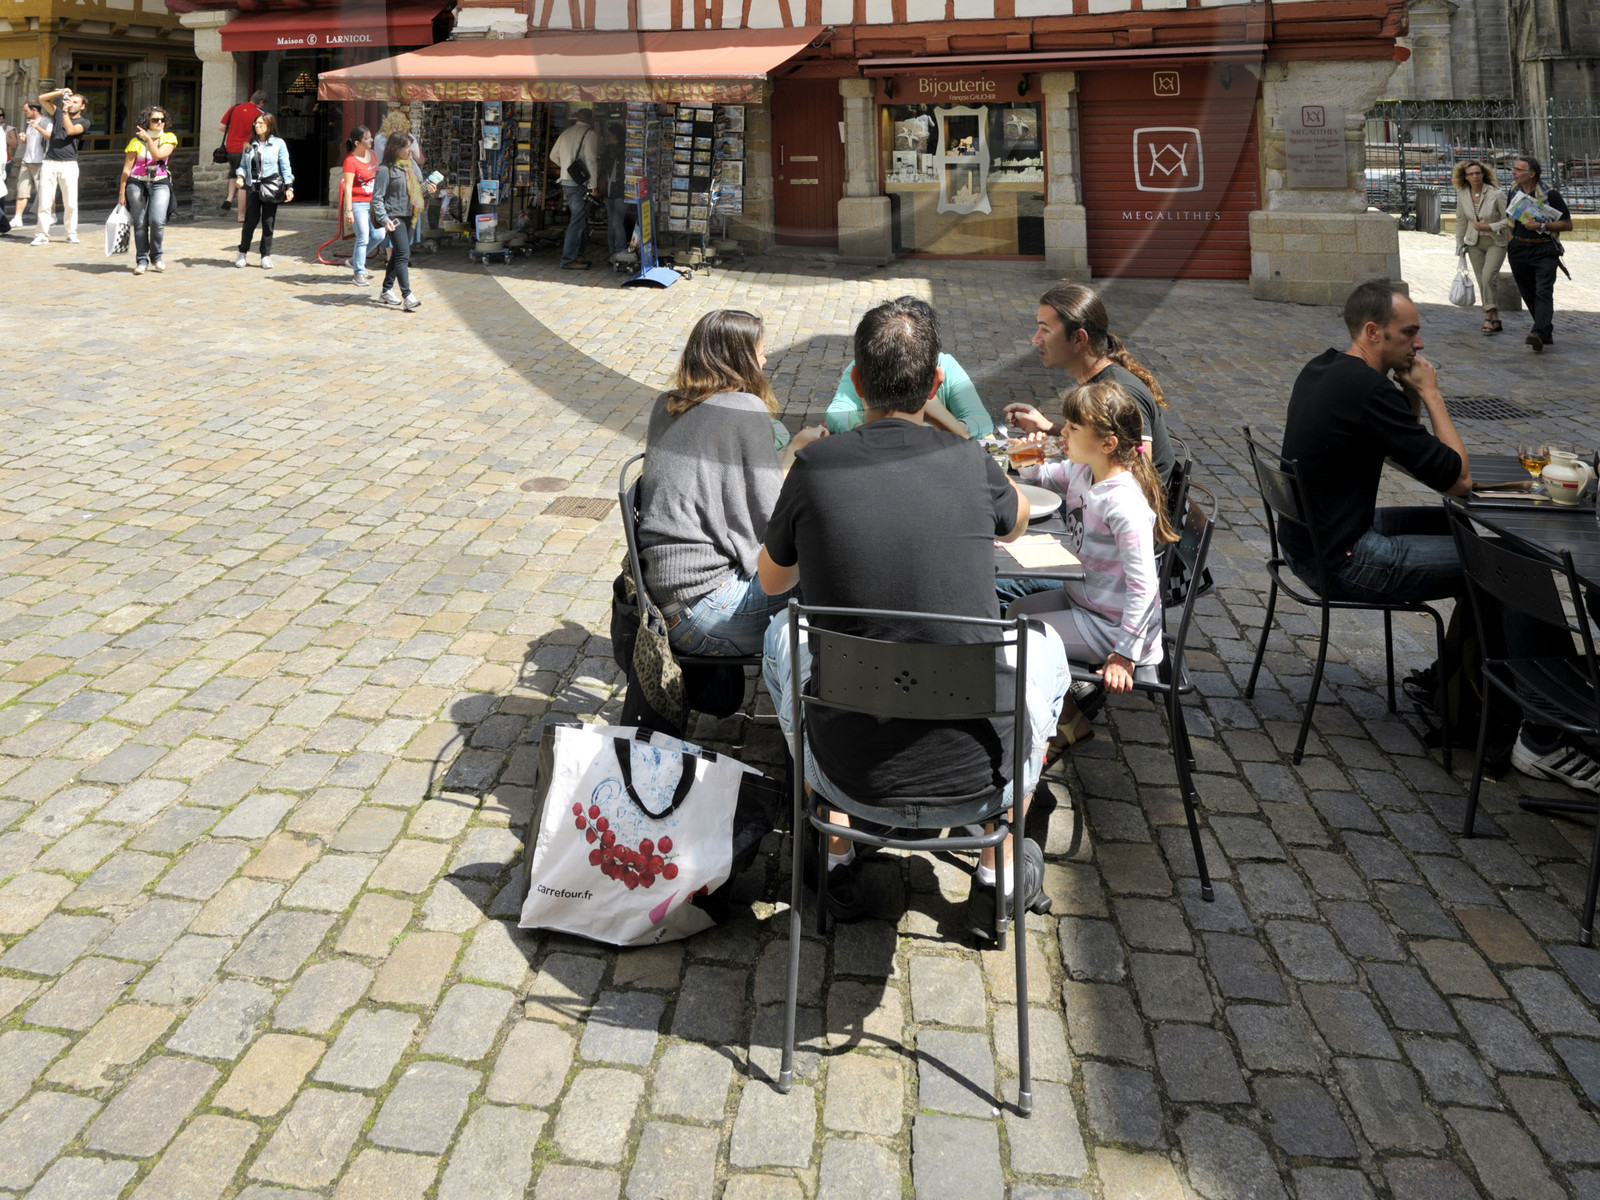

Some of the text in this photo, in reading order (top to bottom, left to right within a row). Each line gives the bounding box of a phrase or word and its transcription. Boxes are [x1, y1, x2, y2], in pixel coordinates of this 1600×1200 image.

[277, 37, 304, 45] Maison
[326, 34, 372, 44] LARNICOL
[434, 81, 501, 100] PRESSE
[521, 81, 574, 100] LOTO
[919, 77, 996, 97] Bijouterie
[1291, 128, 1338, 136] MEGALITHES
[1122, 211, 1221, 221] MEGALITHES
[537, 884, 593, 900] carrefour.fr
